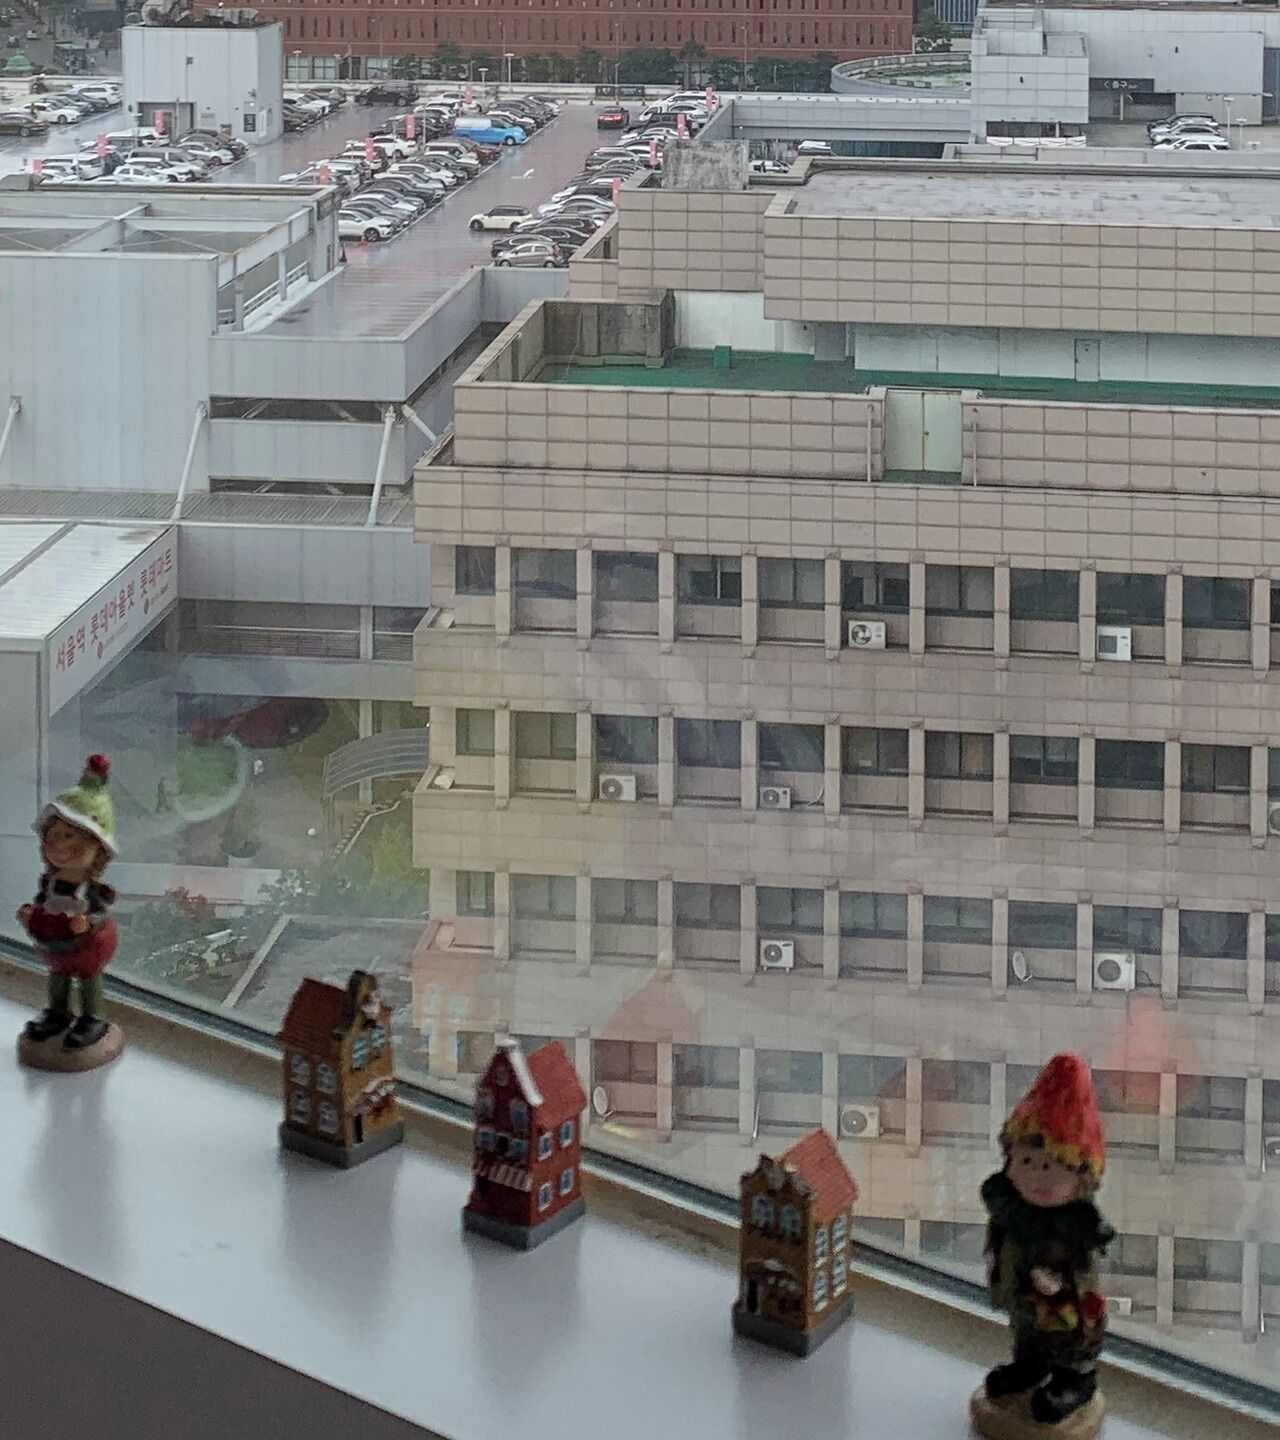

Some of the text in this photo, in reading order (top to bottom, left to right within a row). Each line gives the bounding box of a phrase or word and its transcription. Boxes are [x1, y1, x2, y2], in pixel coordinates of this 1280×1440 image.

[55, 624, 86, 671] 서울역
[90, 579, 135, 645] 롯데아울렛
[139, 548, 173, 597] 롯데마트
